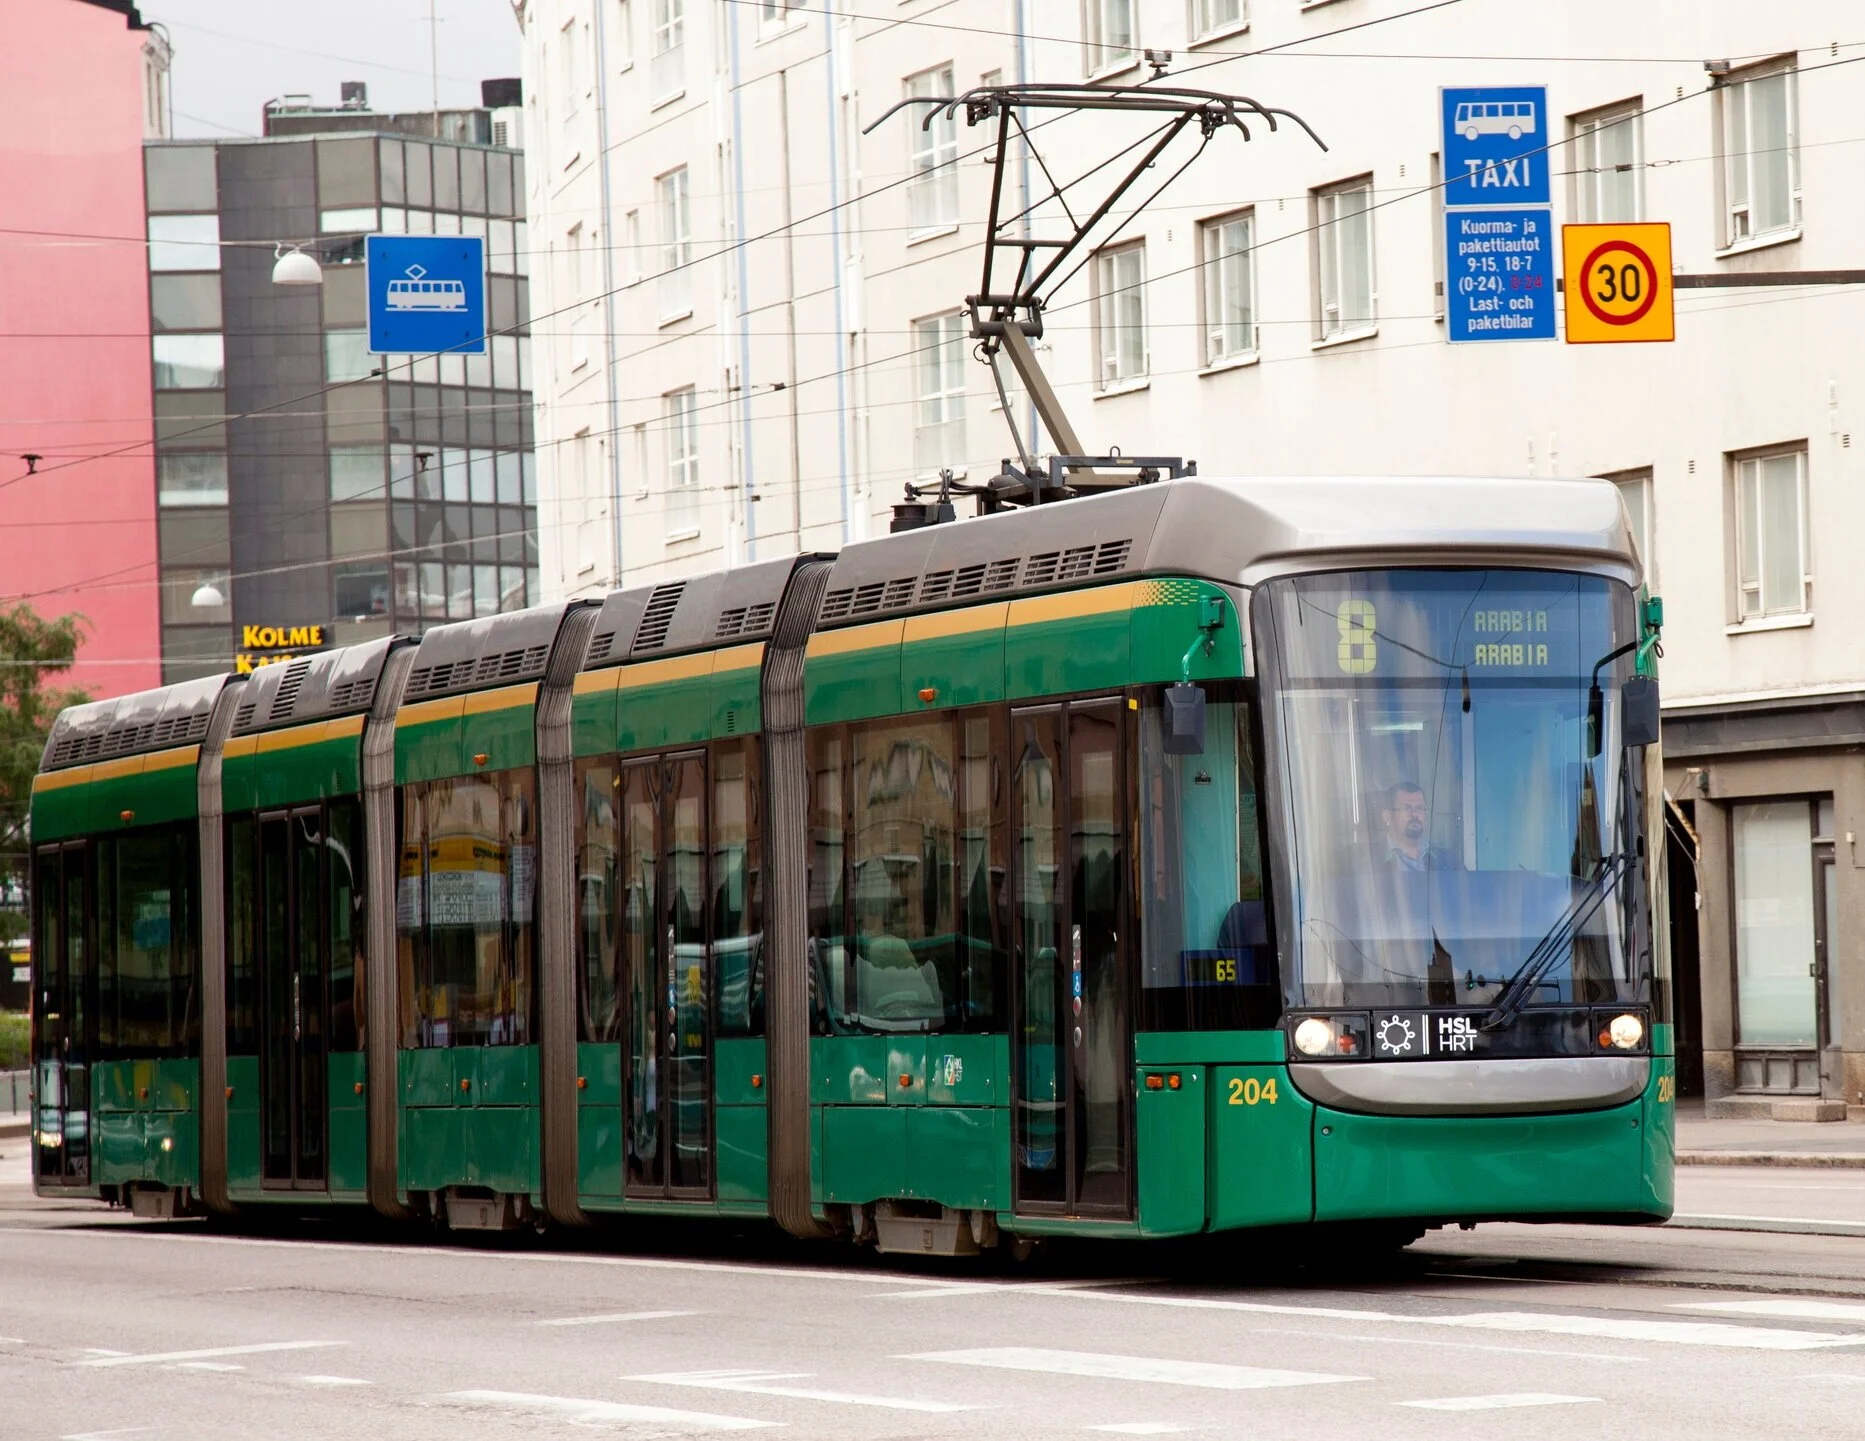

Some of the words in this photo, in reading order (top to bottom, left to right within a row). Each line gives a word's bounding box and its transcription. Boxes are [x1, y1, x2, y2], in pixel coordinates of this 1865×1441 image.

[1464, 158, 1530, 188] TAXI
[1461, 219, 1517, 234] Kuorma-
[1523, 218, 1536, 235] ja
[1459, 236, 1540, 256] pakettiautot
[1504, 255, 1533, 271] 18-7
[1510, 274, 1543, 290] 0-24
[1597, 264, 1641, 302] 30
[1469, 295, 1504, 311] Last-
[1509, 294, 1534, 310] och
[1467, 313, 1534, 333] paketbilar
[1475, 610, 1548, 632] ARABIA
[243, 625, 321, 647] KOLME
[1337, 599, 1377, 674] 8
[1475, 643, 1548, 666] ARABIA
[1216, 959, 1236, 982] 65
[1439, 1017, 1477, 1034] HSL
[1440, 1034, 1477, 1052] HRT
[1229, 1078, 1278, 1105] 204
